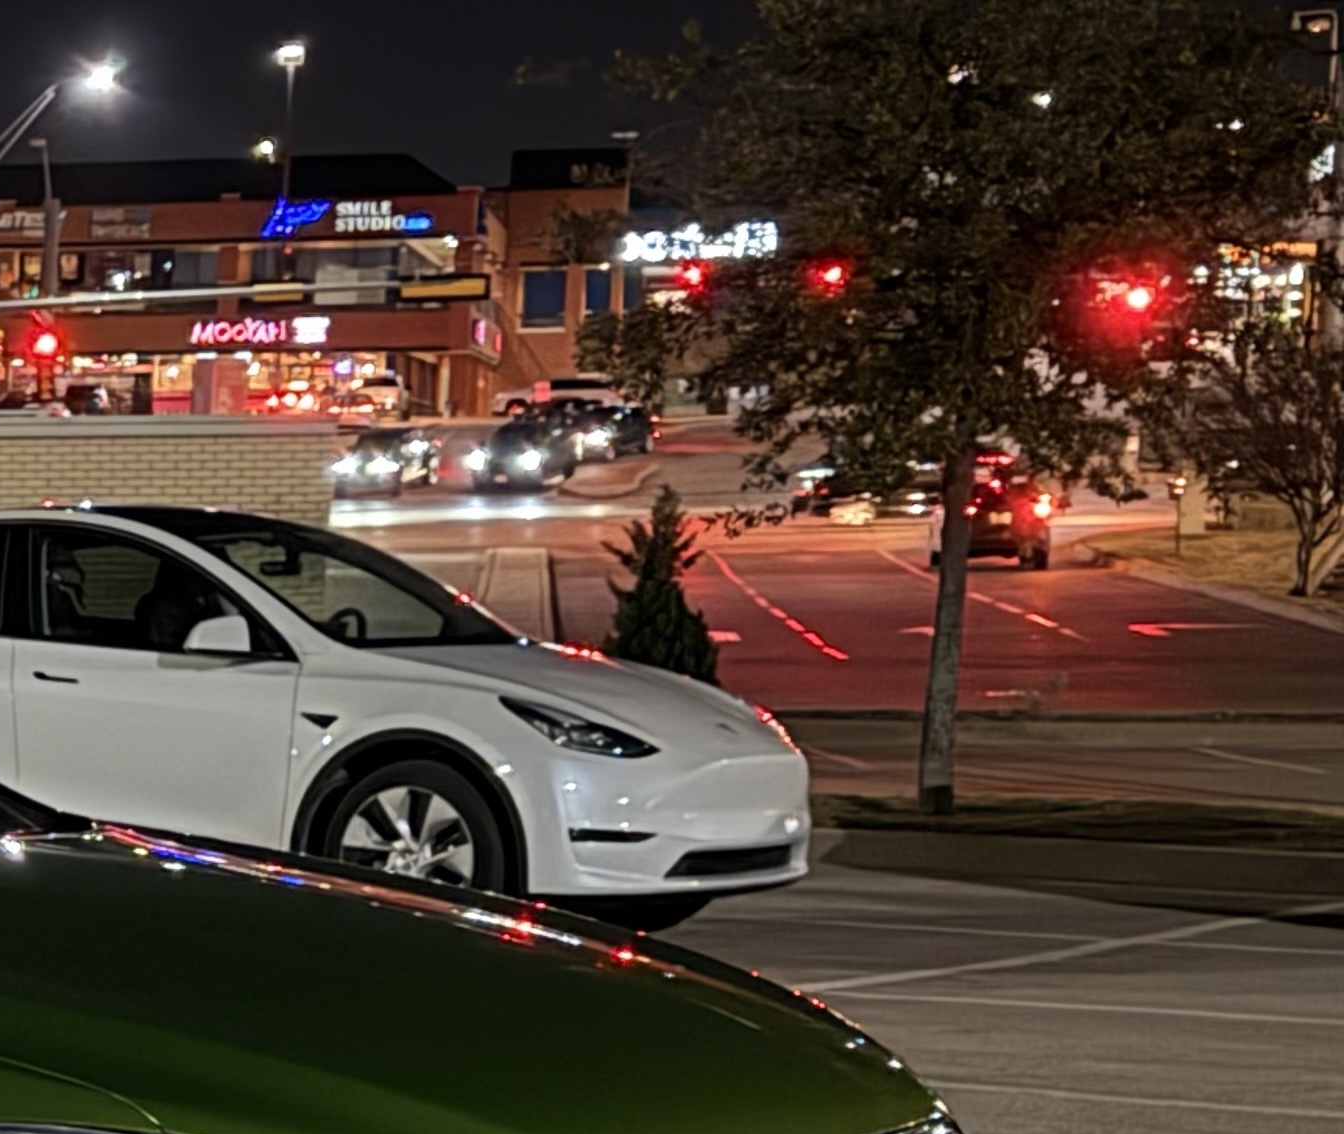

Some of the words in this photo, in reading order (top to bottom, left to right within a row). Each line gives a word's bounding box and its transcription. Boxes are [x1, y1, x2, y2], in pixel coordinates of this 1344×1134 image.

[335, 201, 393, 216] SMILE
[335, 214, 406, 232] STUDIO
[190, 316, 287, 345] MOOYAH
